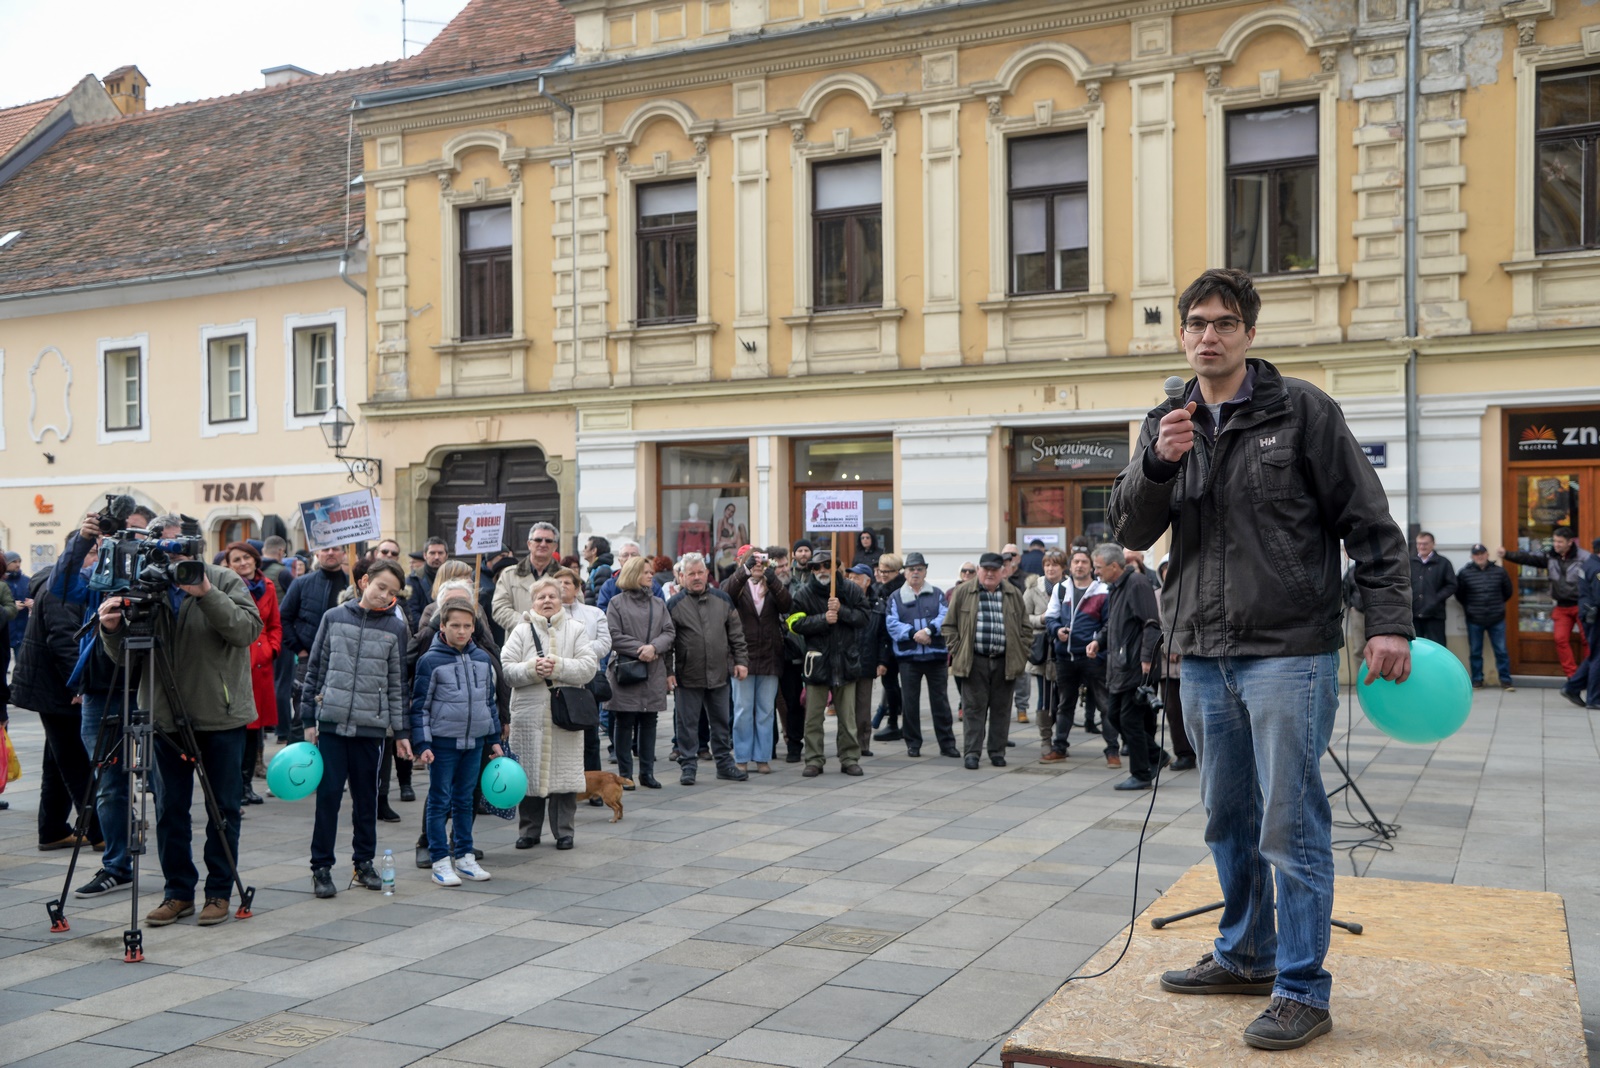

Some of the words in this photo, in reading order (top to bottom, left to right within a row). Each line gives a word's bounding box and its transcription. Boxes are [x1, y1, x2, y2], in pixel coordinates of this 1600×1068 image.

[1259, 436, 1276, 447] HH
[1562, 426, 1600, 445] zn
[1032, 436, 1114, 462] Suvenirnica
[202, 481, 265, 502] TISAK
